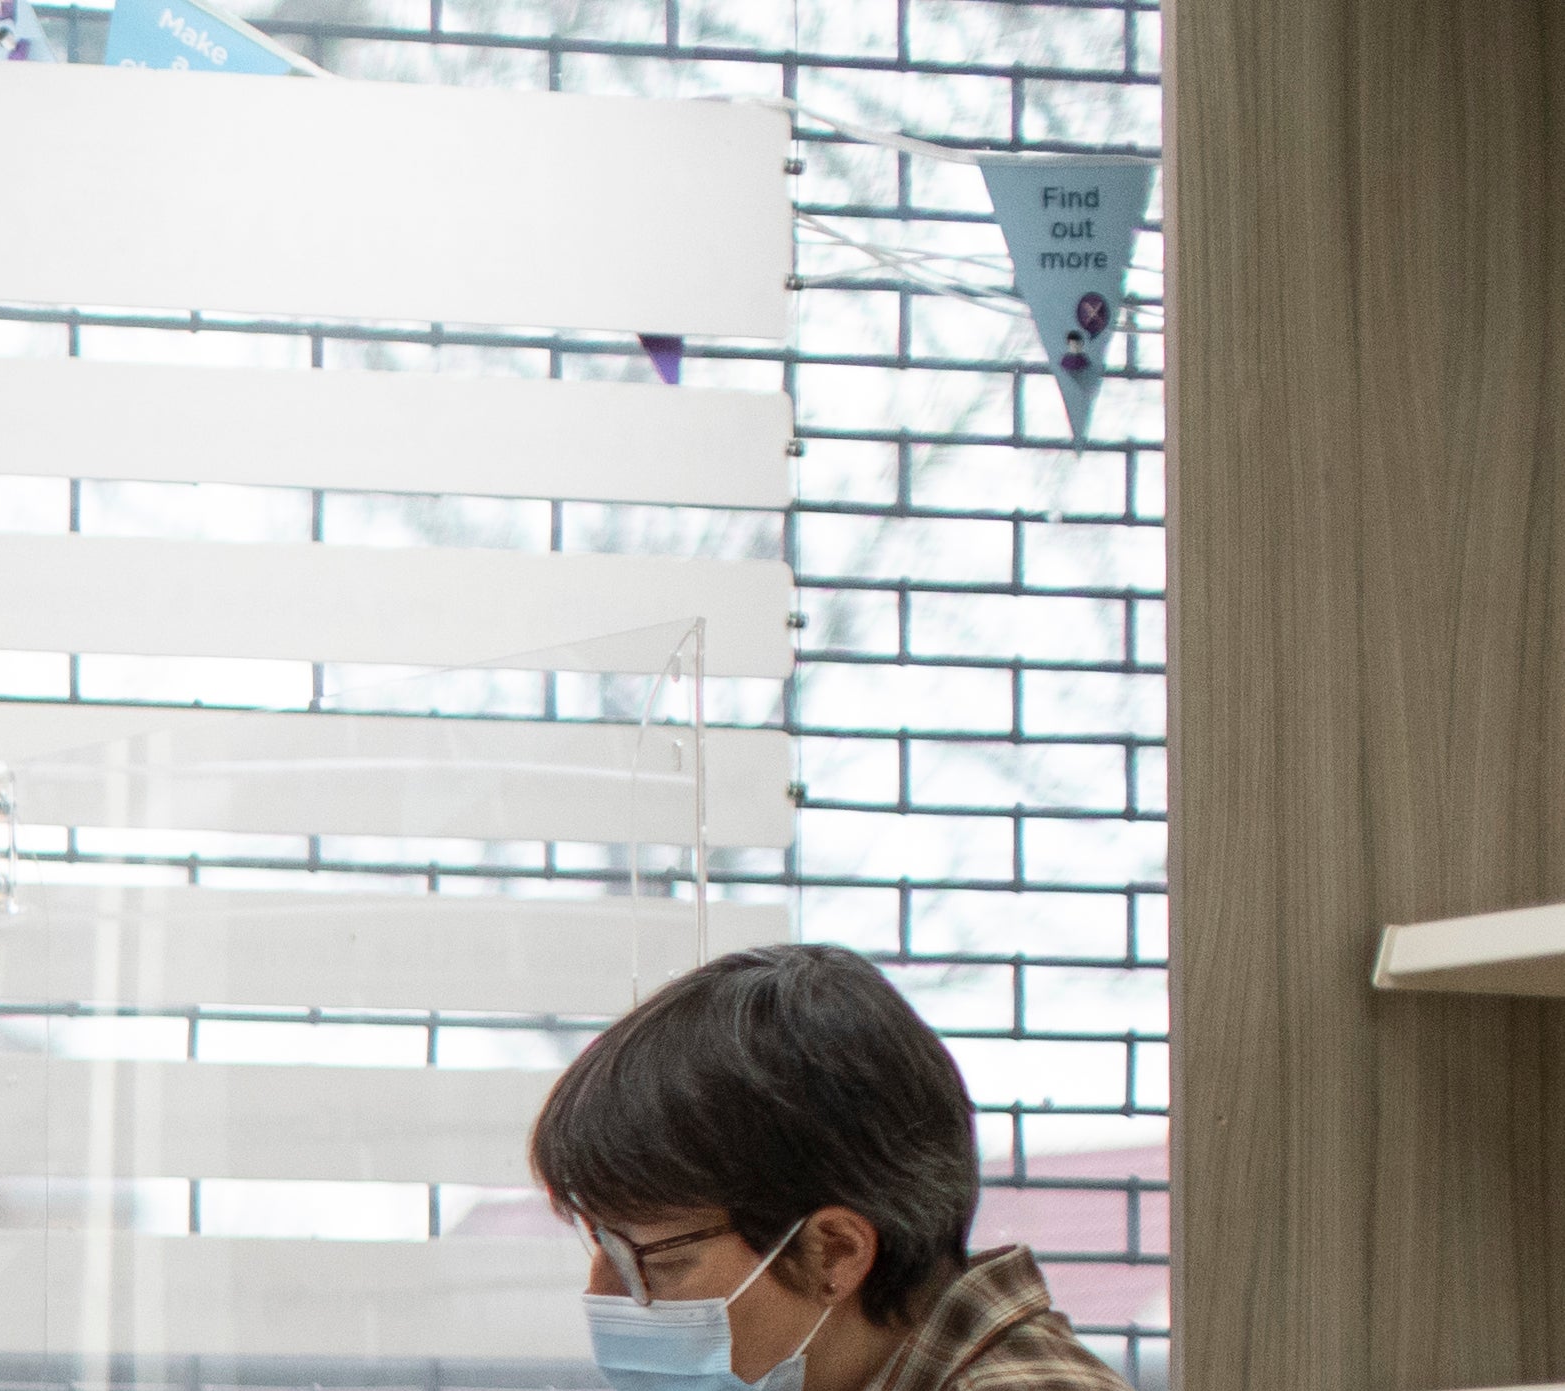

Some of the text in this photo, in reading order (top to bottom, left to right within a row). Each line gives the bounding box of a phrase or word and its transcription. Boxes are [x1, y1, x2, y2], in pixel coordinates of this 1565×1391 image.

[158, 8, 228, 65] Make
[1043, 185, 1100, 209] Find
[1052, 217, 1094, 239] out
[1040, 251, 1108, 269] more
